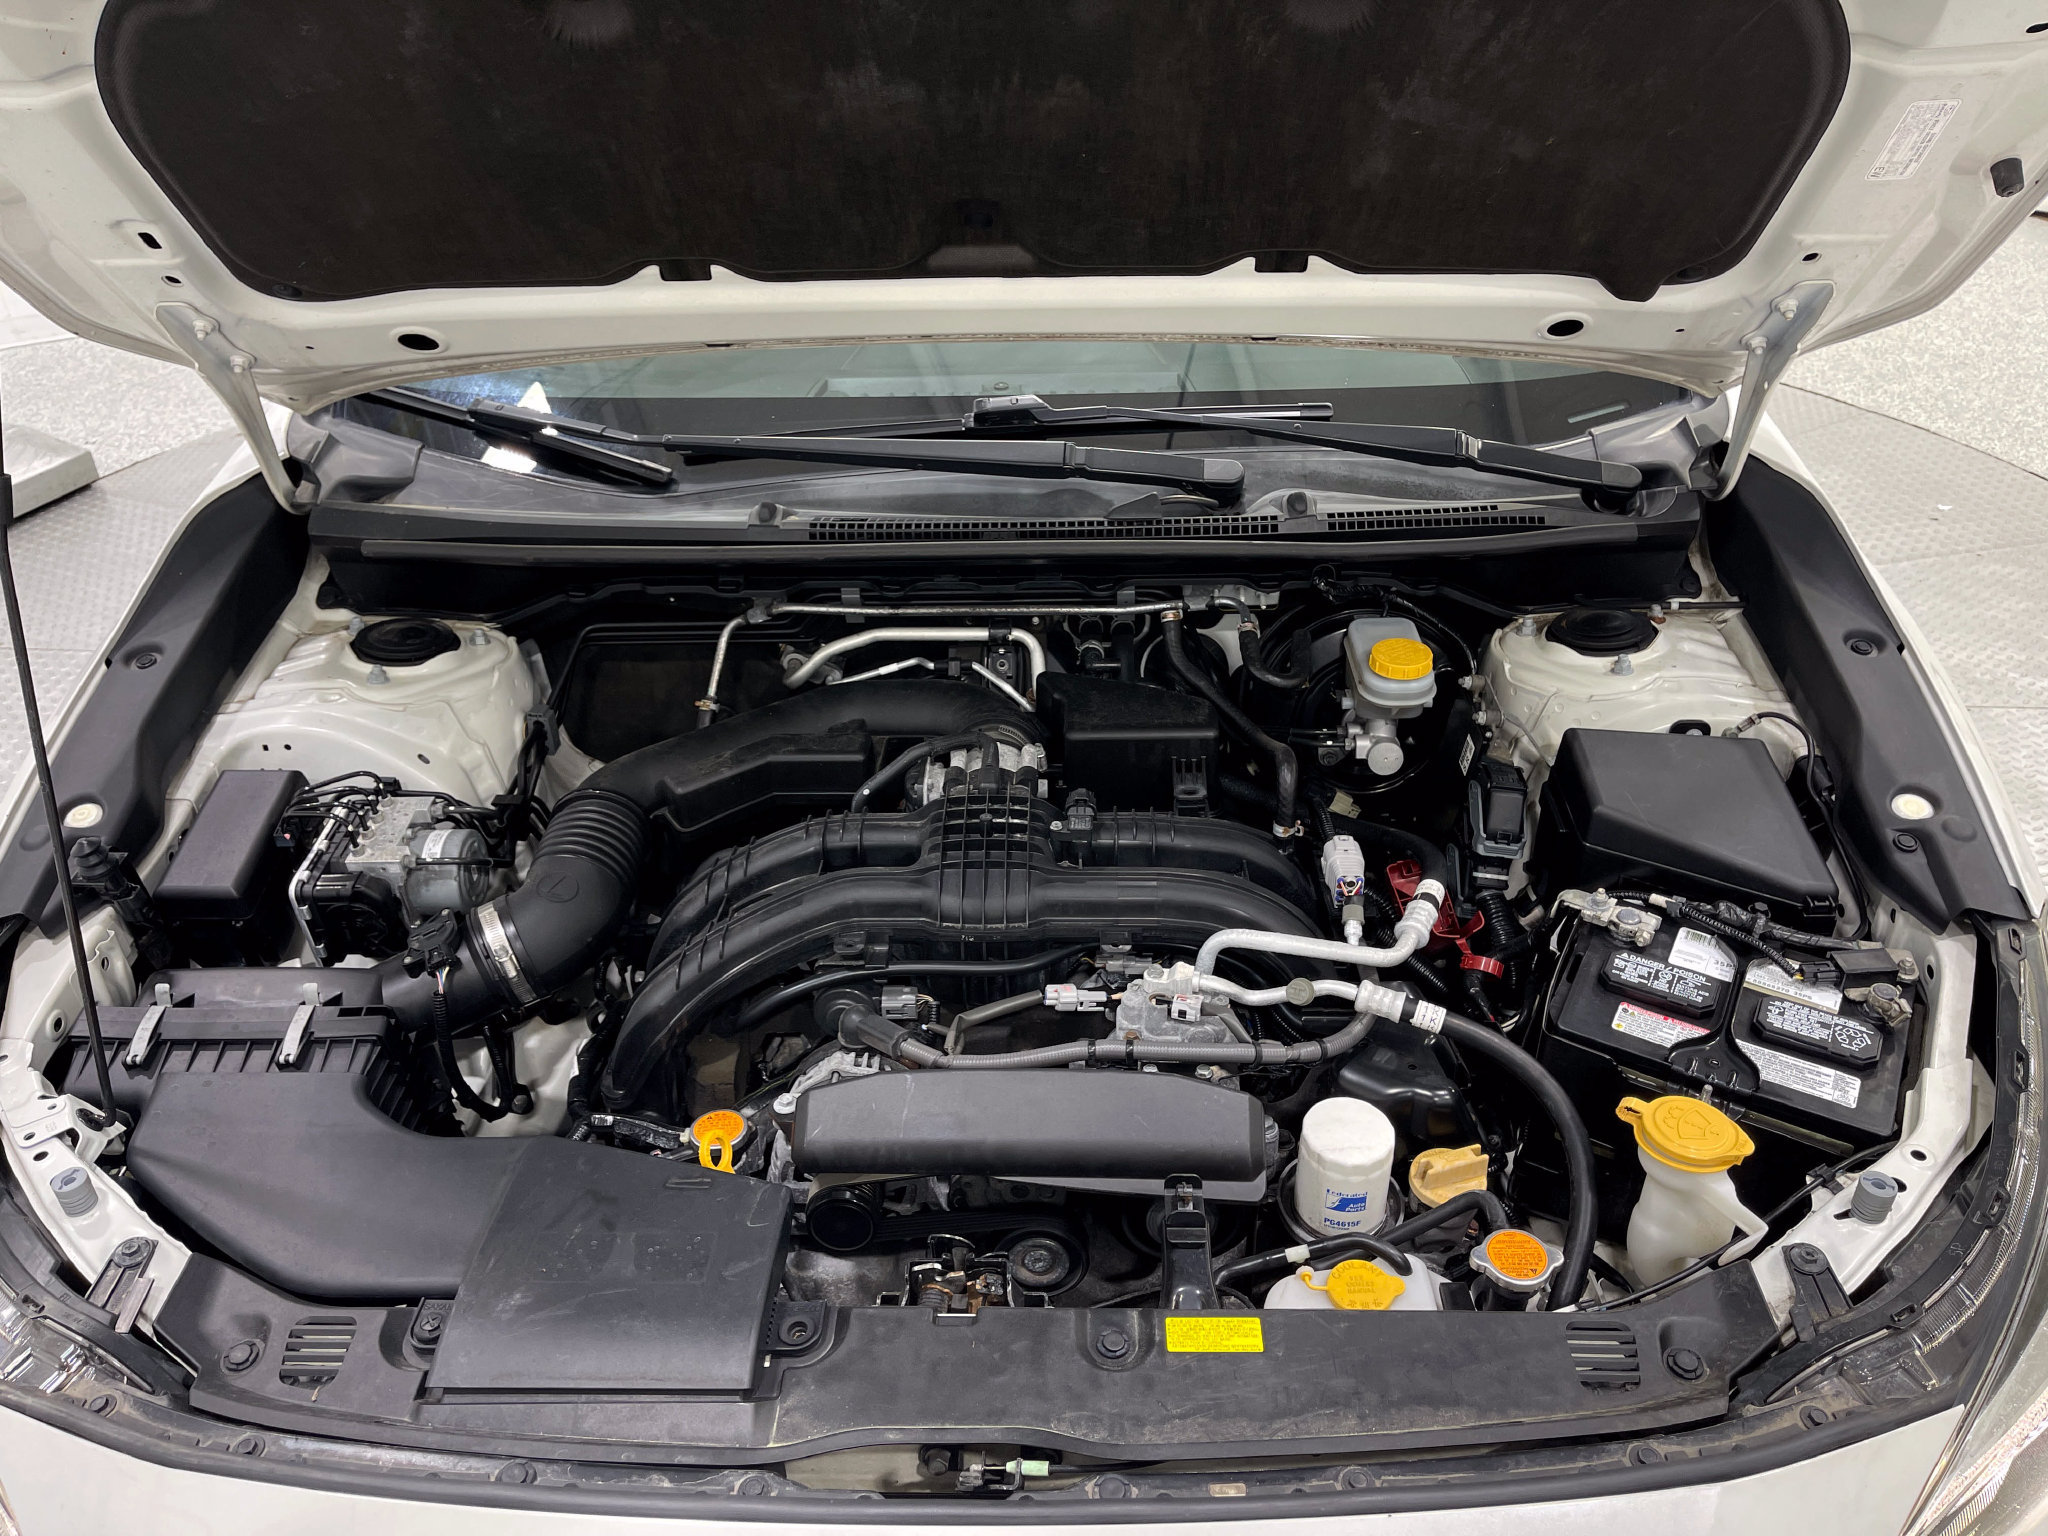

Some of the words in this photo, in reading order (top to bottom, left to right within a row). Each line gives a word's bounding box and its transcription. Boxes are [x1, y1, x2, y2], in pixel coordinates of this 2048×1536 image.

[1629, 955, 1666, 971] DANGER
[1674, 968, 1706, 982] POISON
[1332, 1261, 1385, 1280] COOLANT
